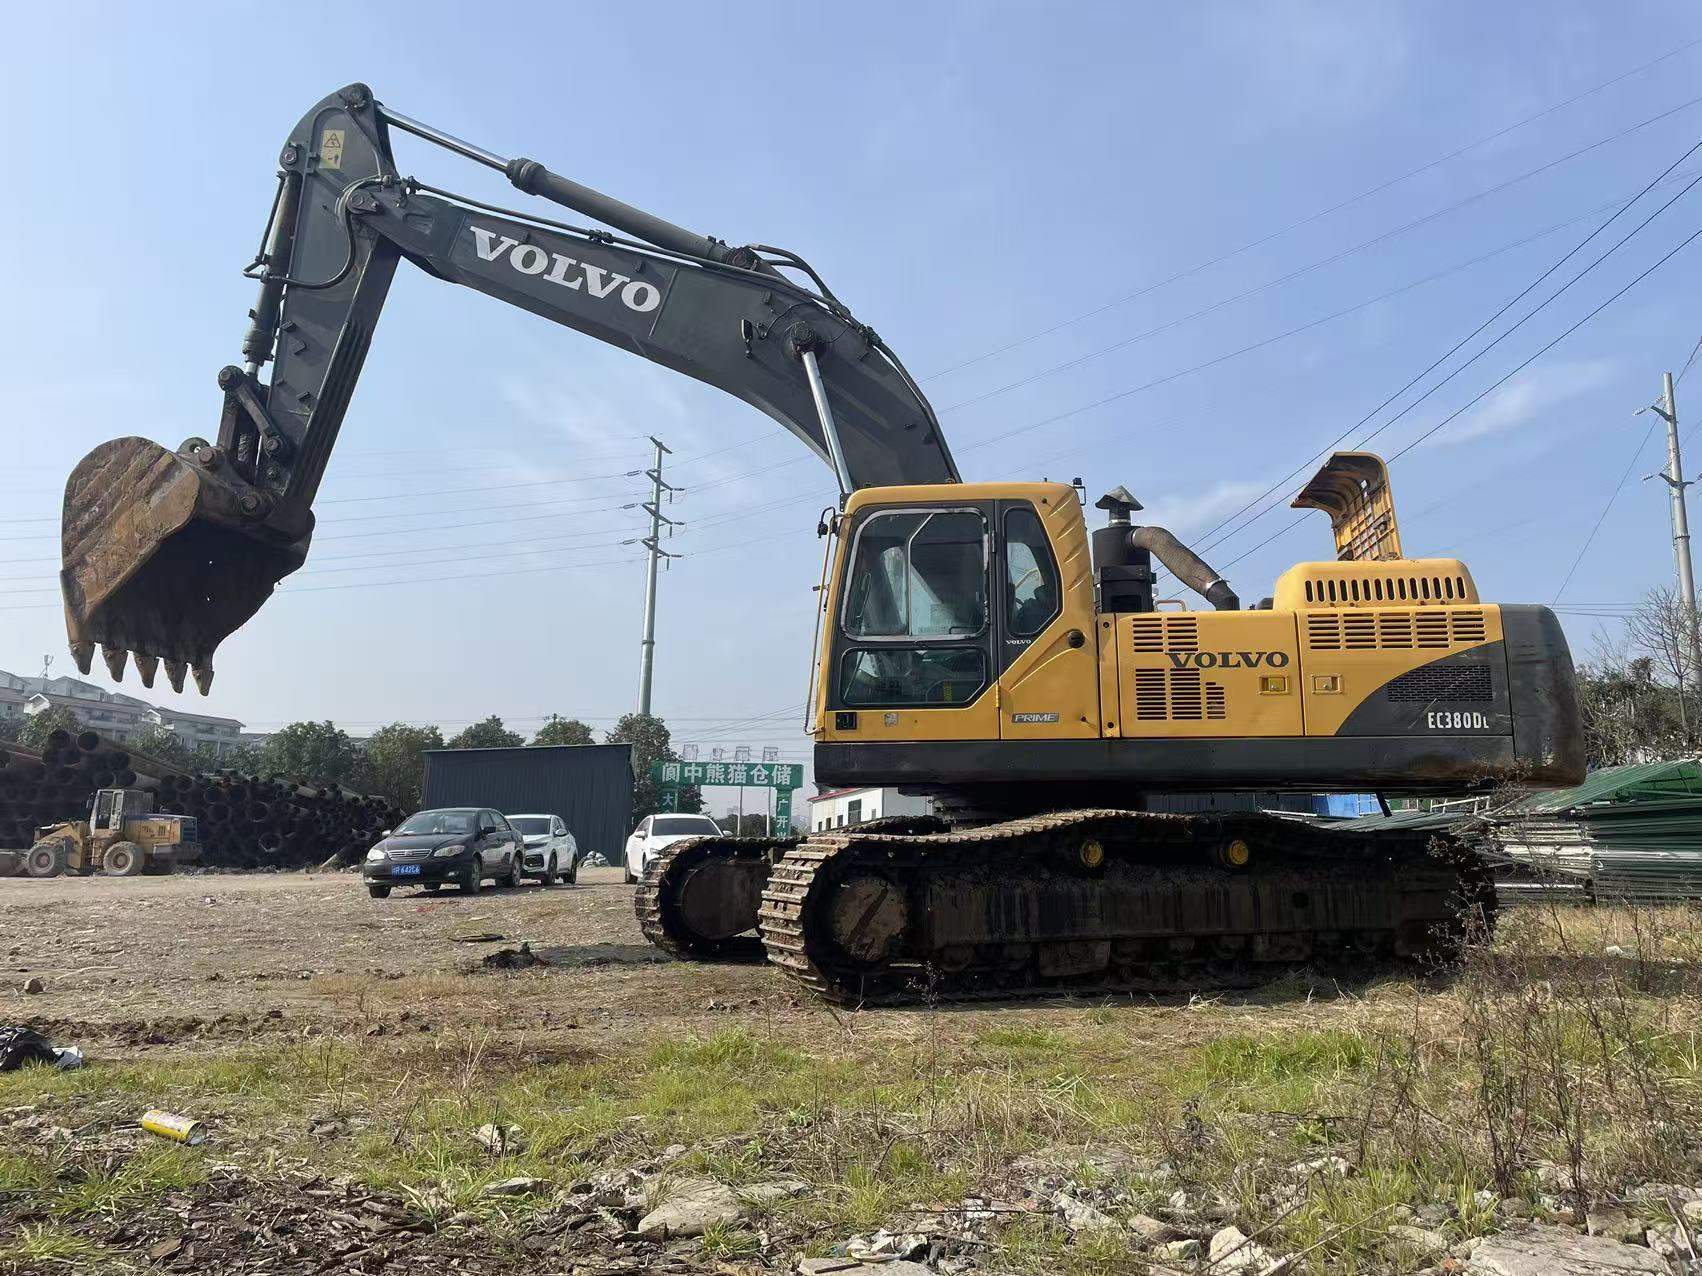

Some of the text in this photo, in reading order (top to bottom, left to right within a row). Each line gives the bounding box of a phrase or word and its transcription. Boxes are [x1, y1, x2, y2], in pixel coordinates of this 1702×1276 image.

[469, 225, 662, 313] VOLVO
[1164, 651, 1290, 668] VOLVO
[1014, 713, 1058, 722] PRIME
[661, 762, 792, 786] 阆中熊猫仓储
